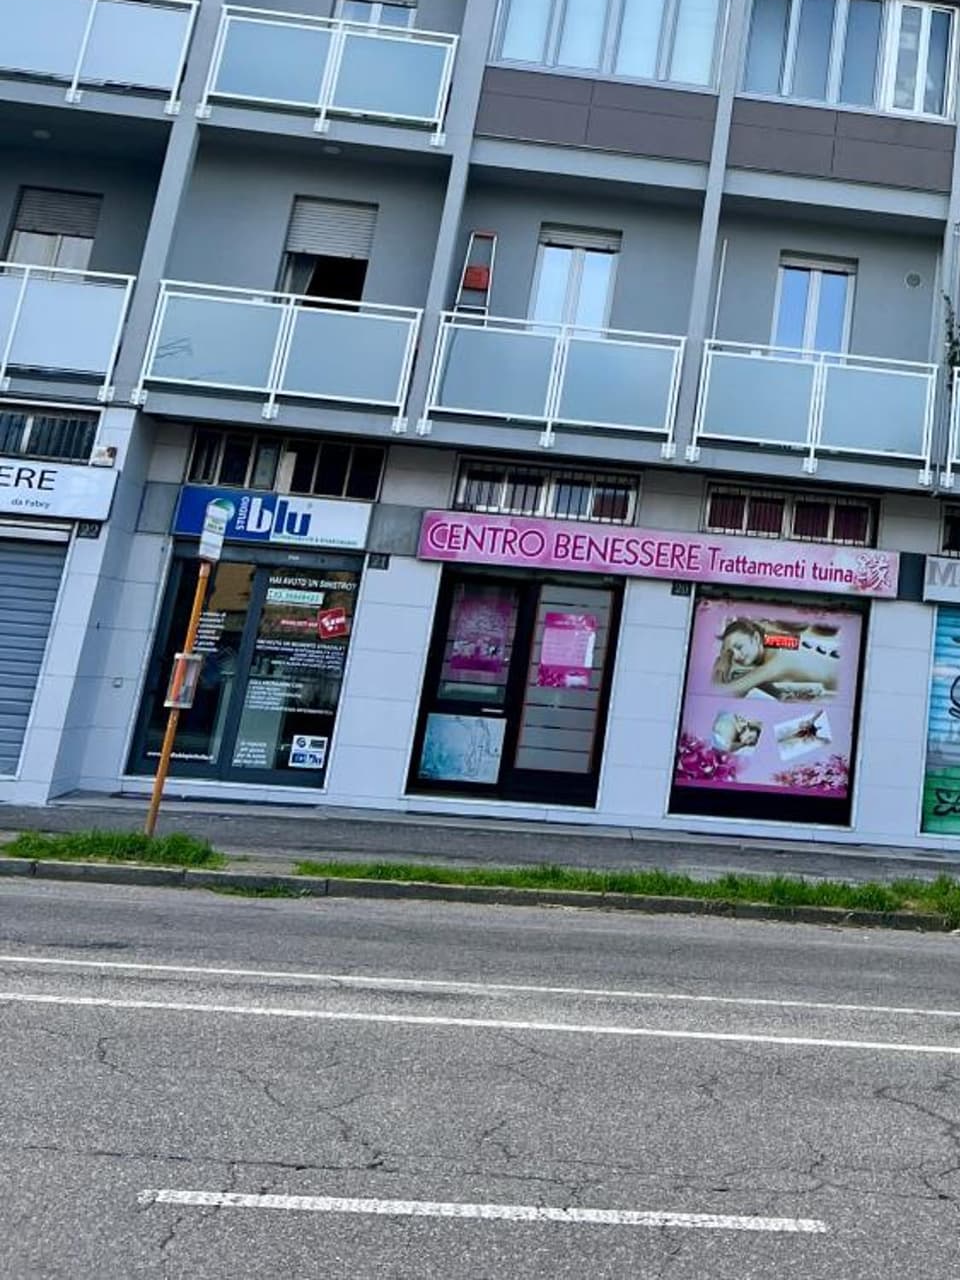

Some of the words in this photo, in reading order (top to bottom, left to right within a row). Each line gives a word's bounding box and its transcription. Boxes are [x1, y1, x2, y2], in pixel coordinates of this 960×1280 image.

[11, 498, 23, 506] da
[235, 495, 250, 531] STUDIO
[246, 497, 312, 537] blu
[429, 523, 546, 558] CENTRO
[554, 533, 702, 570] BENESSERE
[708, 547, 806, 579] Trattamenti
[812, 561, 854, 583] tuina
